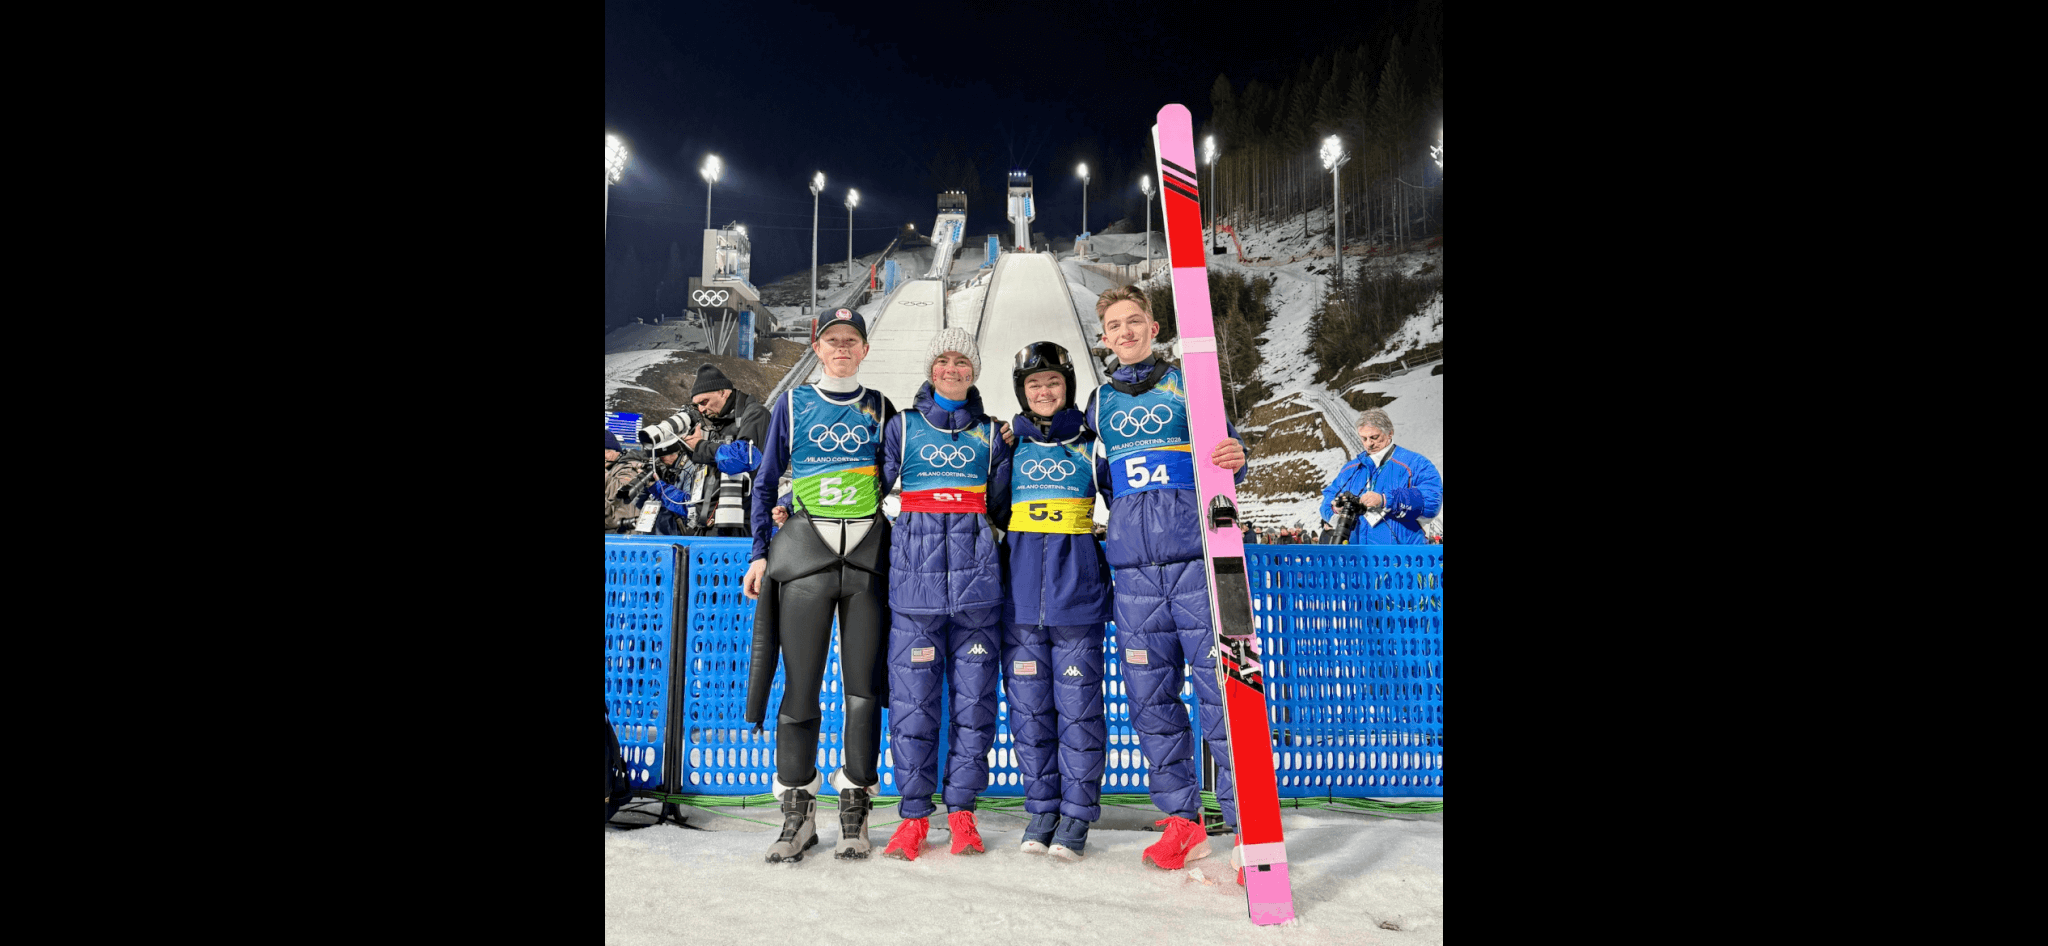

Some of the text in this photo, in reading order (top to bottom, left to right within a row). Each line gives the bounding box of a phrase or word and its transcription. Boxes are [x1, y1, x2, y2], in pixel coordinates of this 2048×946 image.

[1110, 441, 1134, 452] MILANO
[1125, 456, 1170, 489] 54
[818, 477, 858, 506] 52
